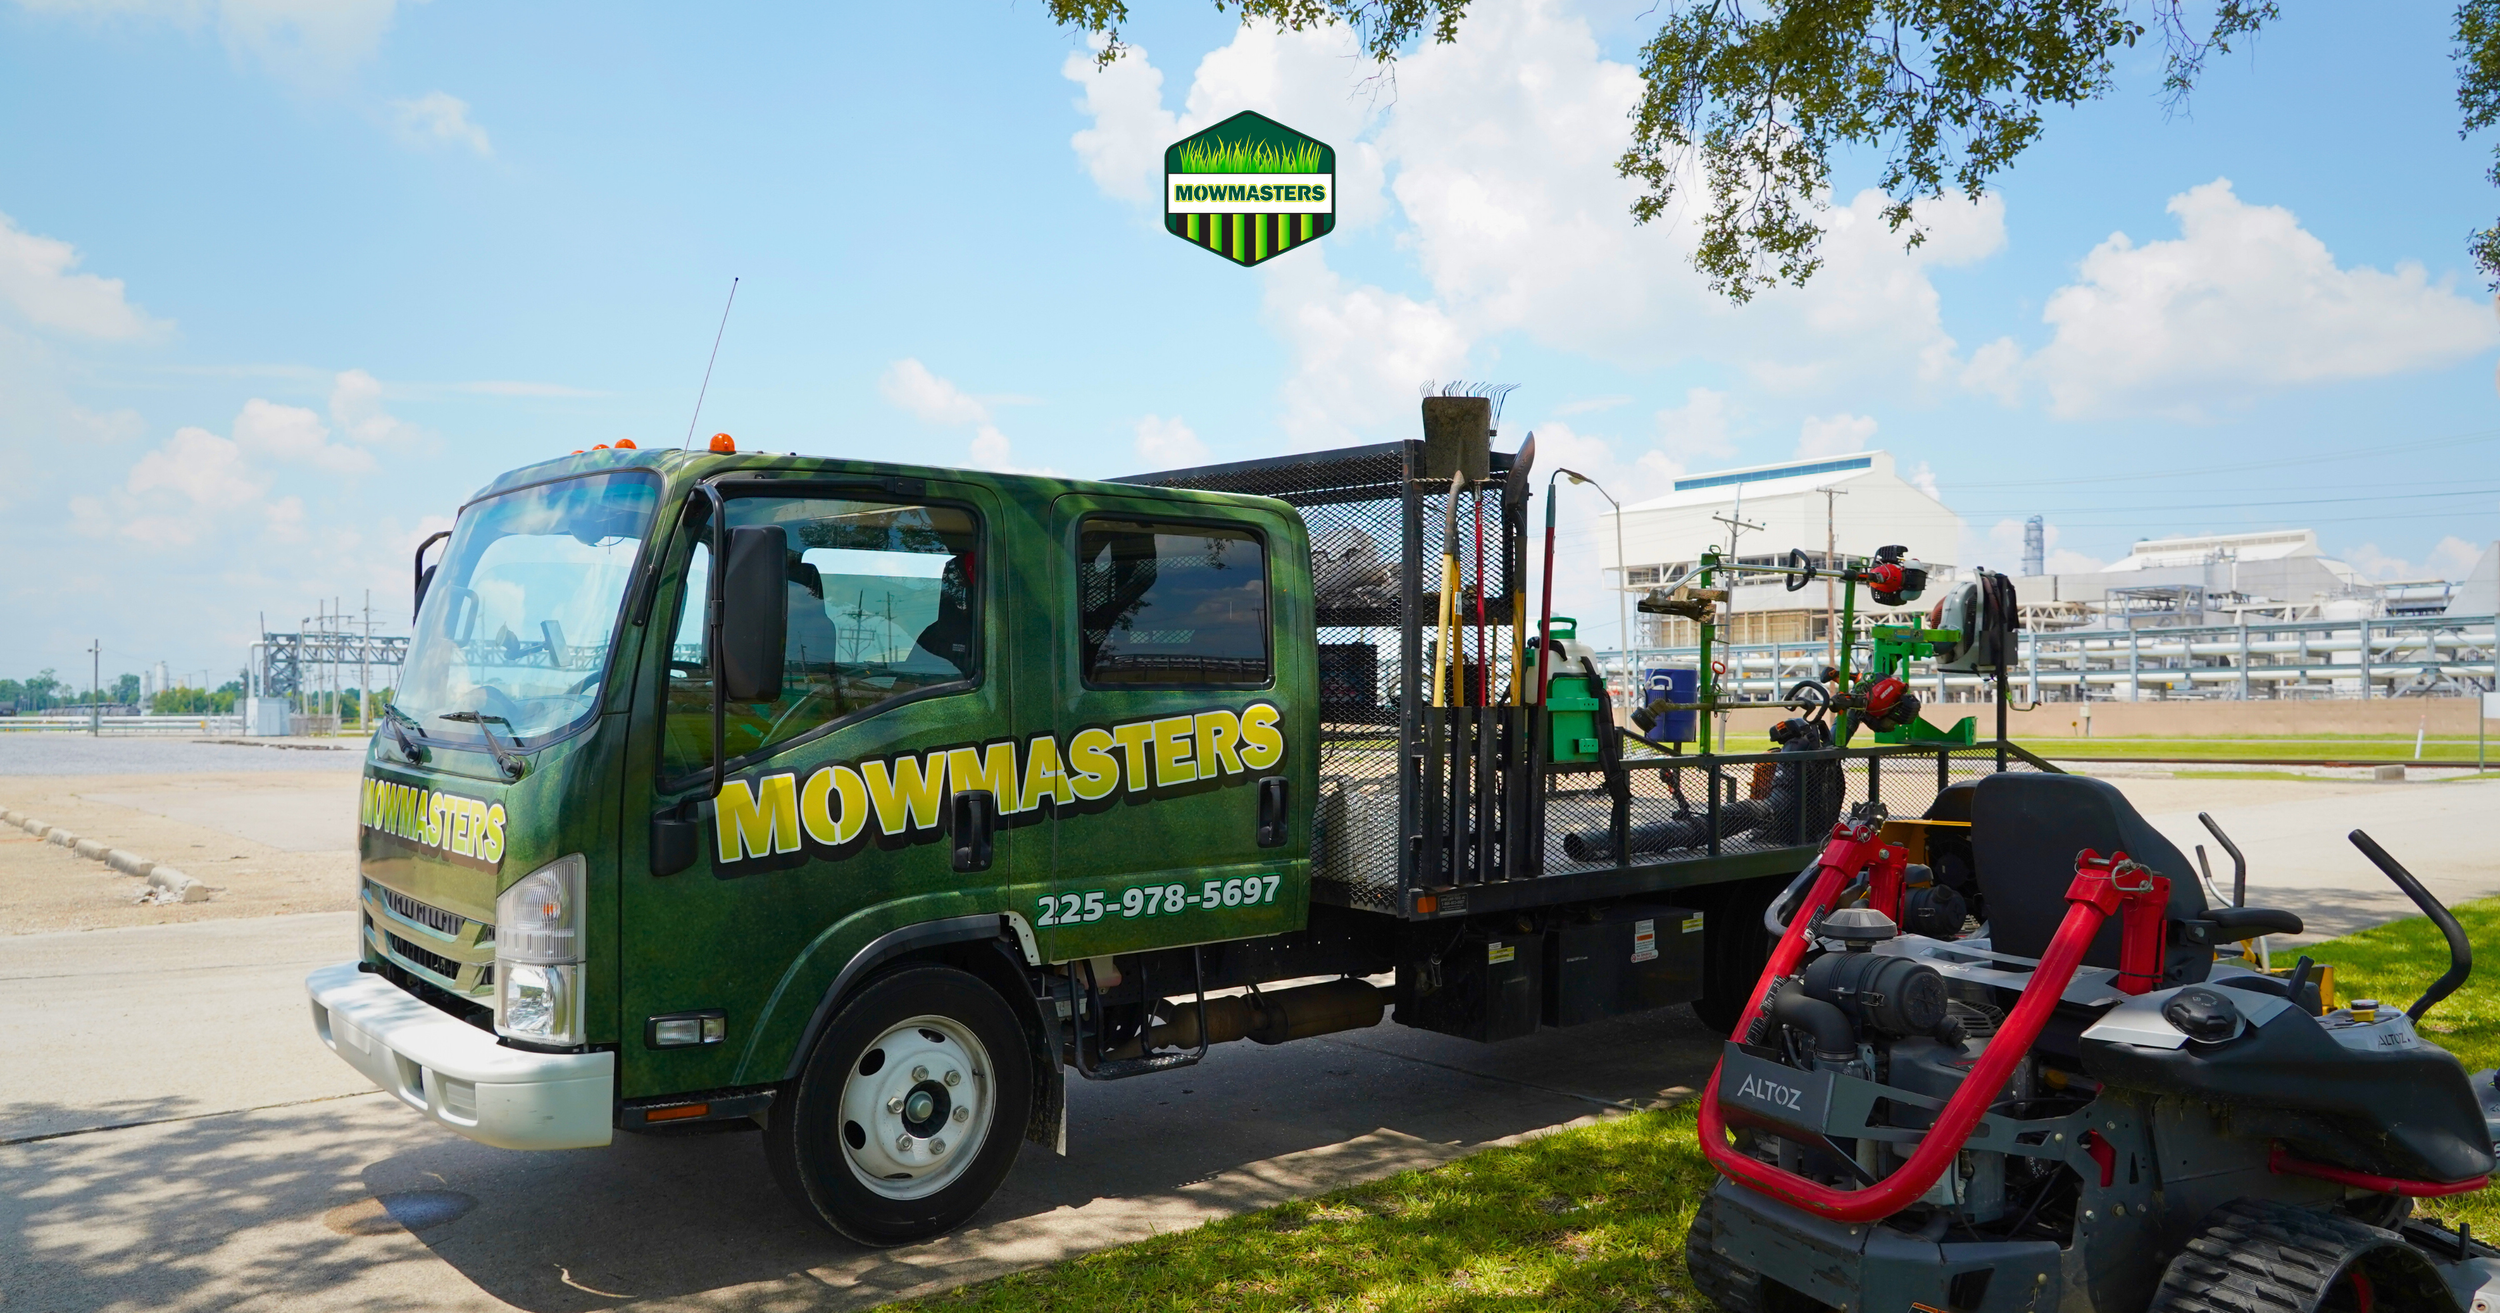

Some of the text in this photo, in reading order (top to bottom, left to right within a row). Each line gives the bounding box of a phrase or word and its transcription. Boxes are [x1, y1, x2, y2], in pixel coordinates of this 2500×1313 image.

[713, 703, 1284, 864] MOWMASTERS
[362, 776, 506, 864] MOWMASTERS
[1037, 873, 1282, 928] 225-978-5697
[1736, 1073, 1803, 1112] ALTOZ
